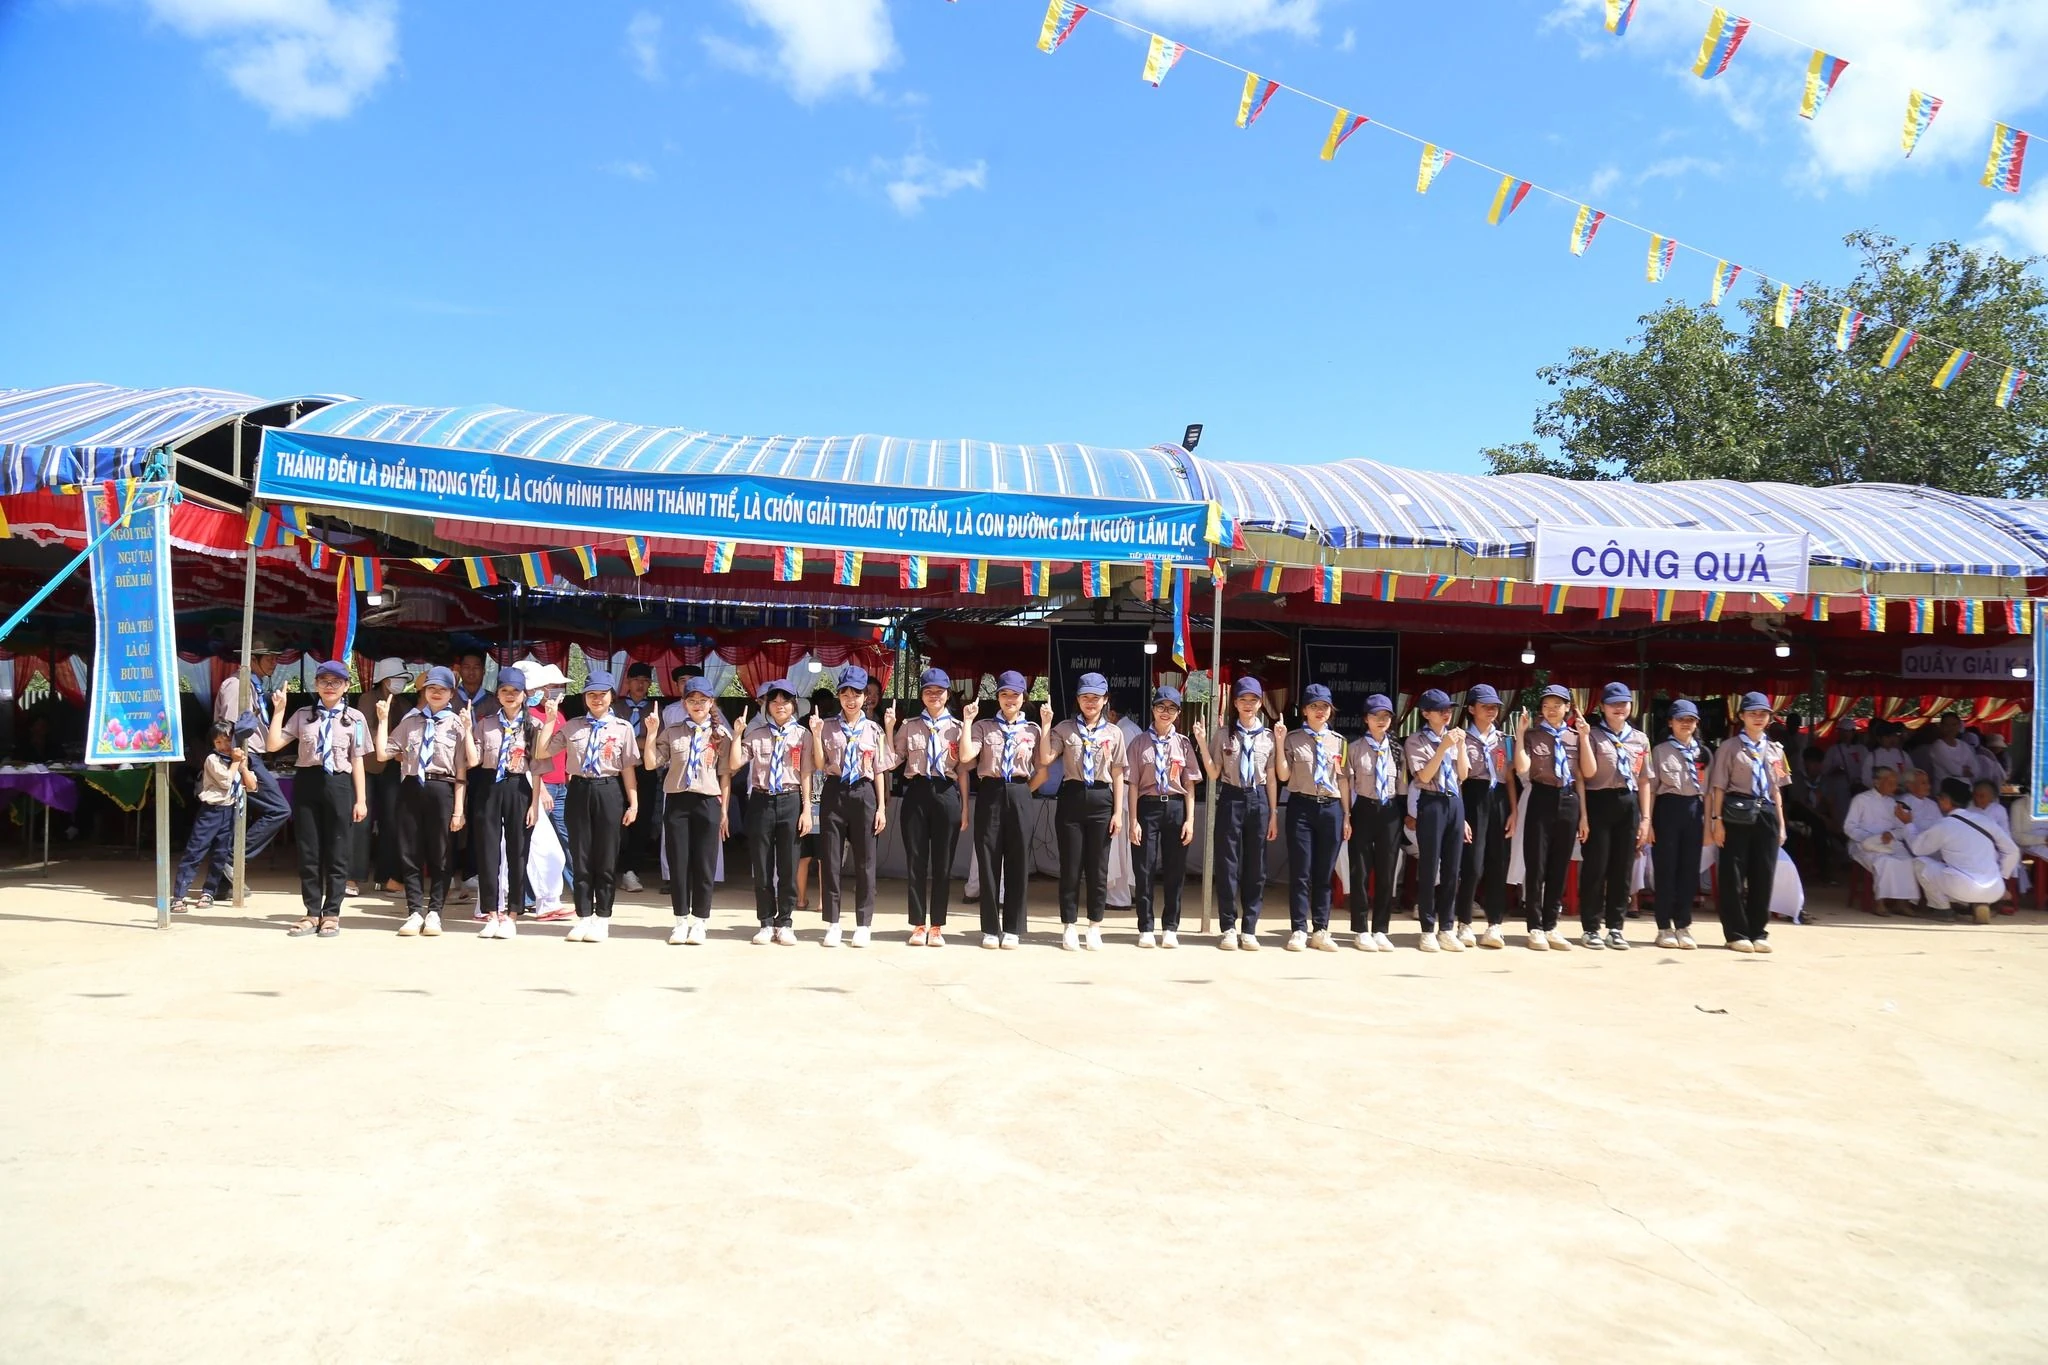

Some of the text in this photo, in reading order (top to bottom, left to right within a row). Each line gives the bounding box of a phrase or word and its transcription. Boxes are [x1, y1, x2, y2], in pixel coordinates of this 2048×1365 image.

[276, 450, 1197, 552] THÁNH ĐỀN LÀ ĐIỂM TRỌNG YẾU, LÀ CHỐN HÌNH THÀNH THÁNH THỂ, LÀ CHỐN GIẢI THOÁT NỢ TRẦN, LÀ CON ĐƯỜNG DẮT NGƯỜI LẦM LẠC
[1571, 539, 1771, 582] CÔNG QUẢ
